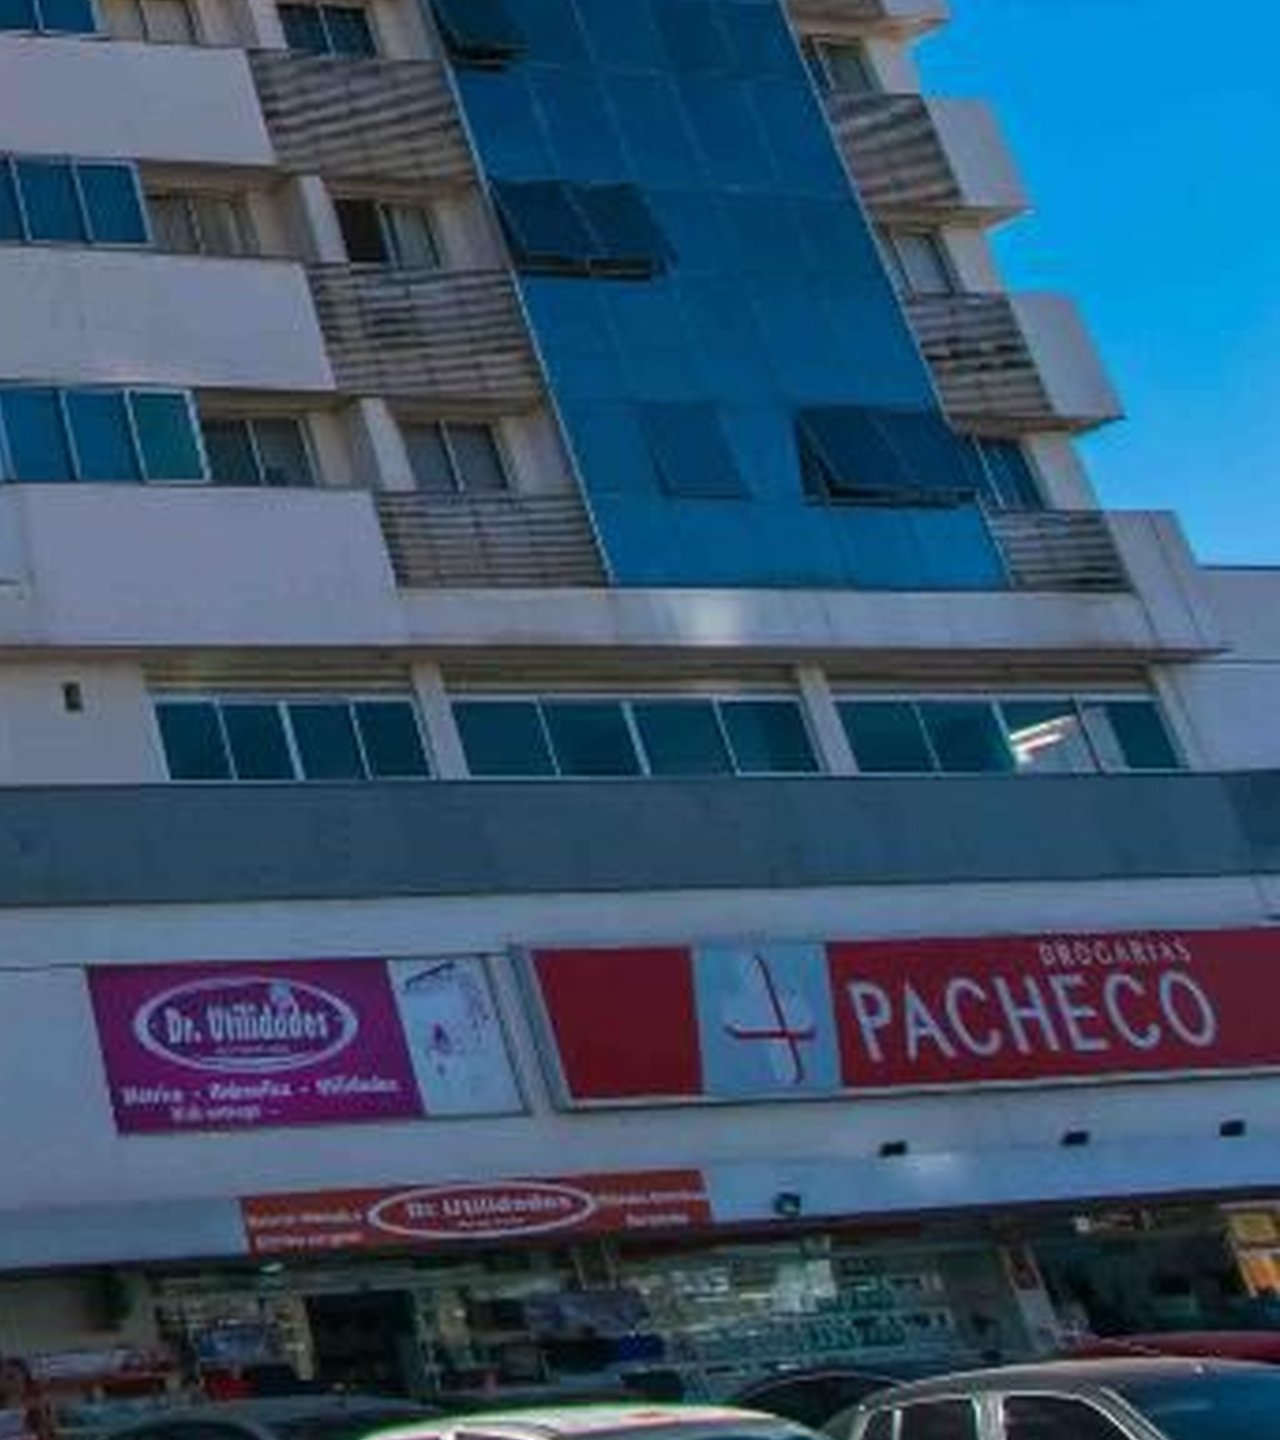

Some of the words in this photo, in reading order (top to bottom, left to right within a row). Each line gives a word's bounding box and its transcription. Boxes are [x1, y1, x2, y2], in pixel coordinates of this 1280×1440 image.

[1041, 939, 1192, 966] DROGARIAS
[164, 1007, 201, 1044] Dr.
[206, 1001, 328, 1042] Utilidades
[848, 970, 1217, 1061] PACHECO
